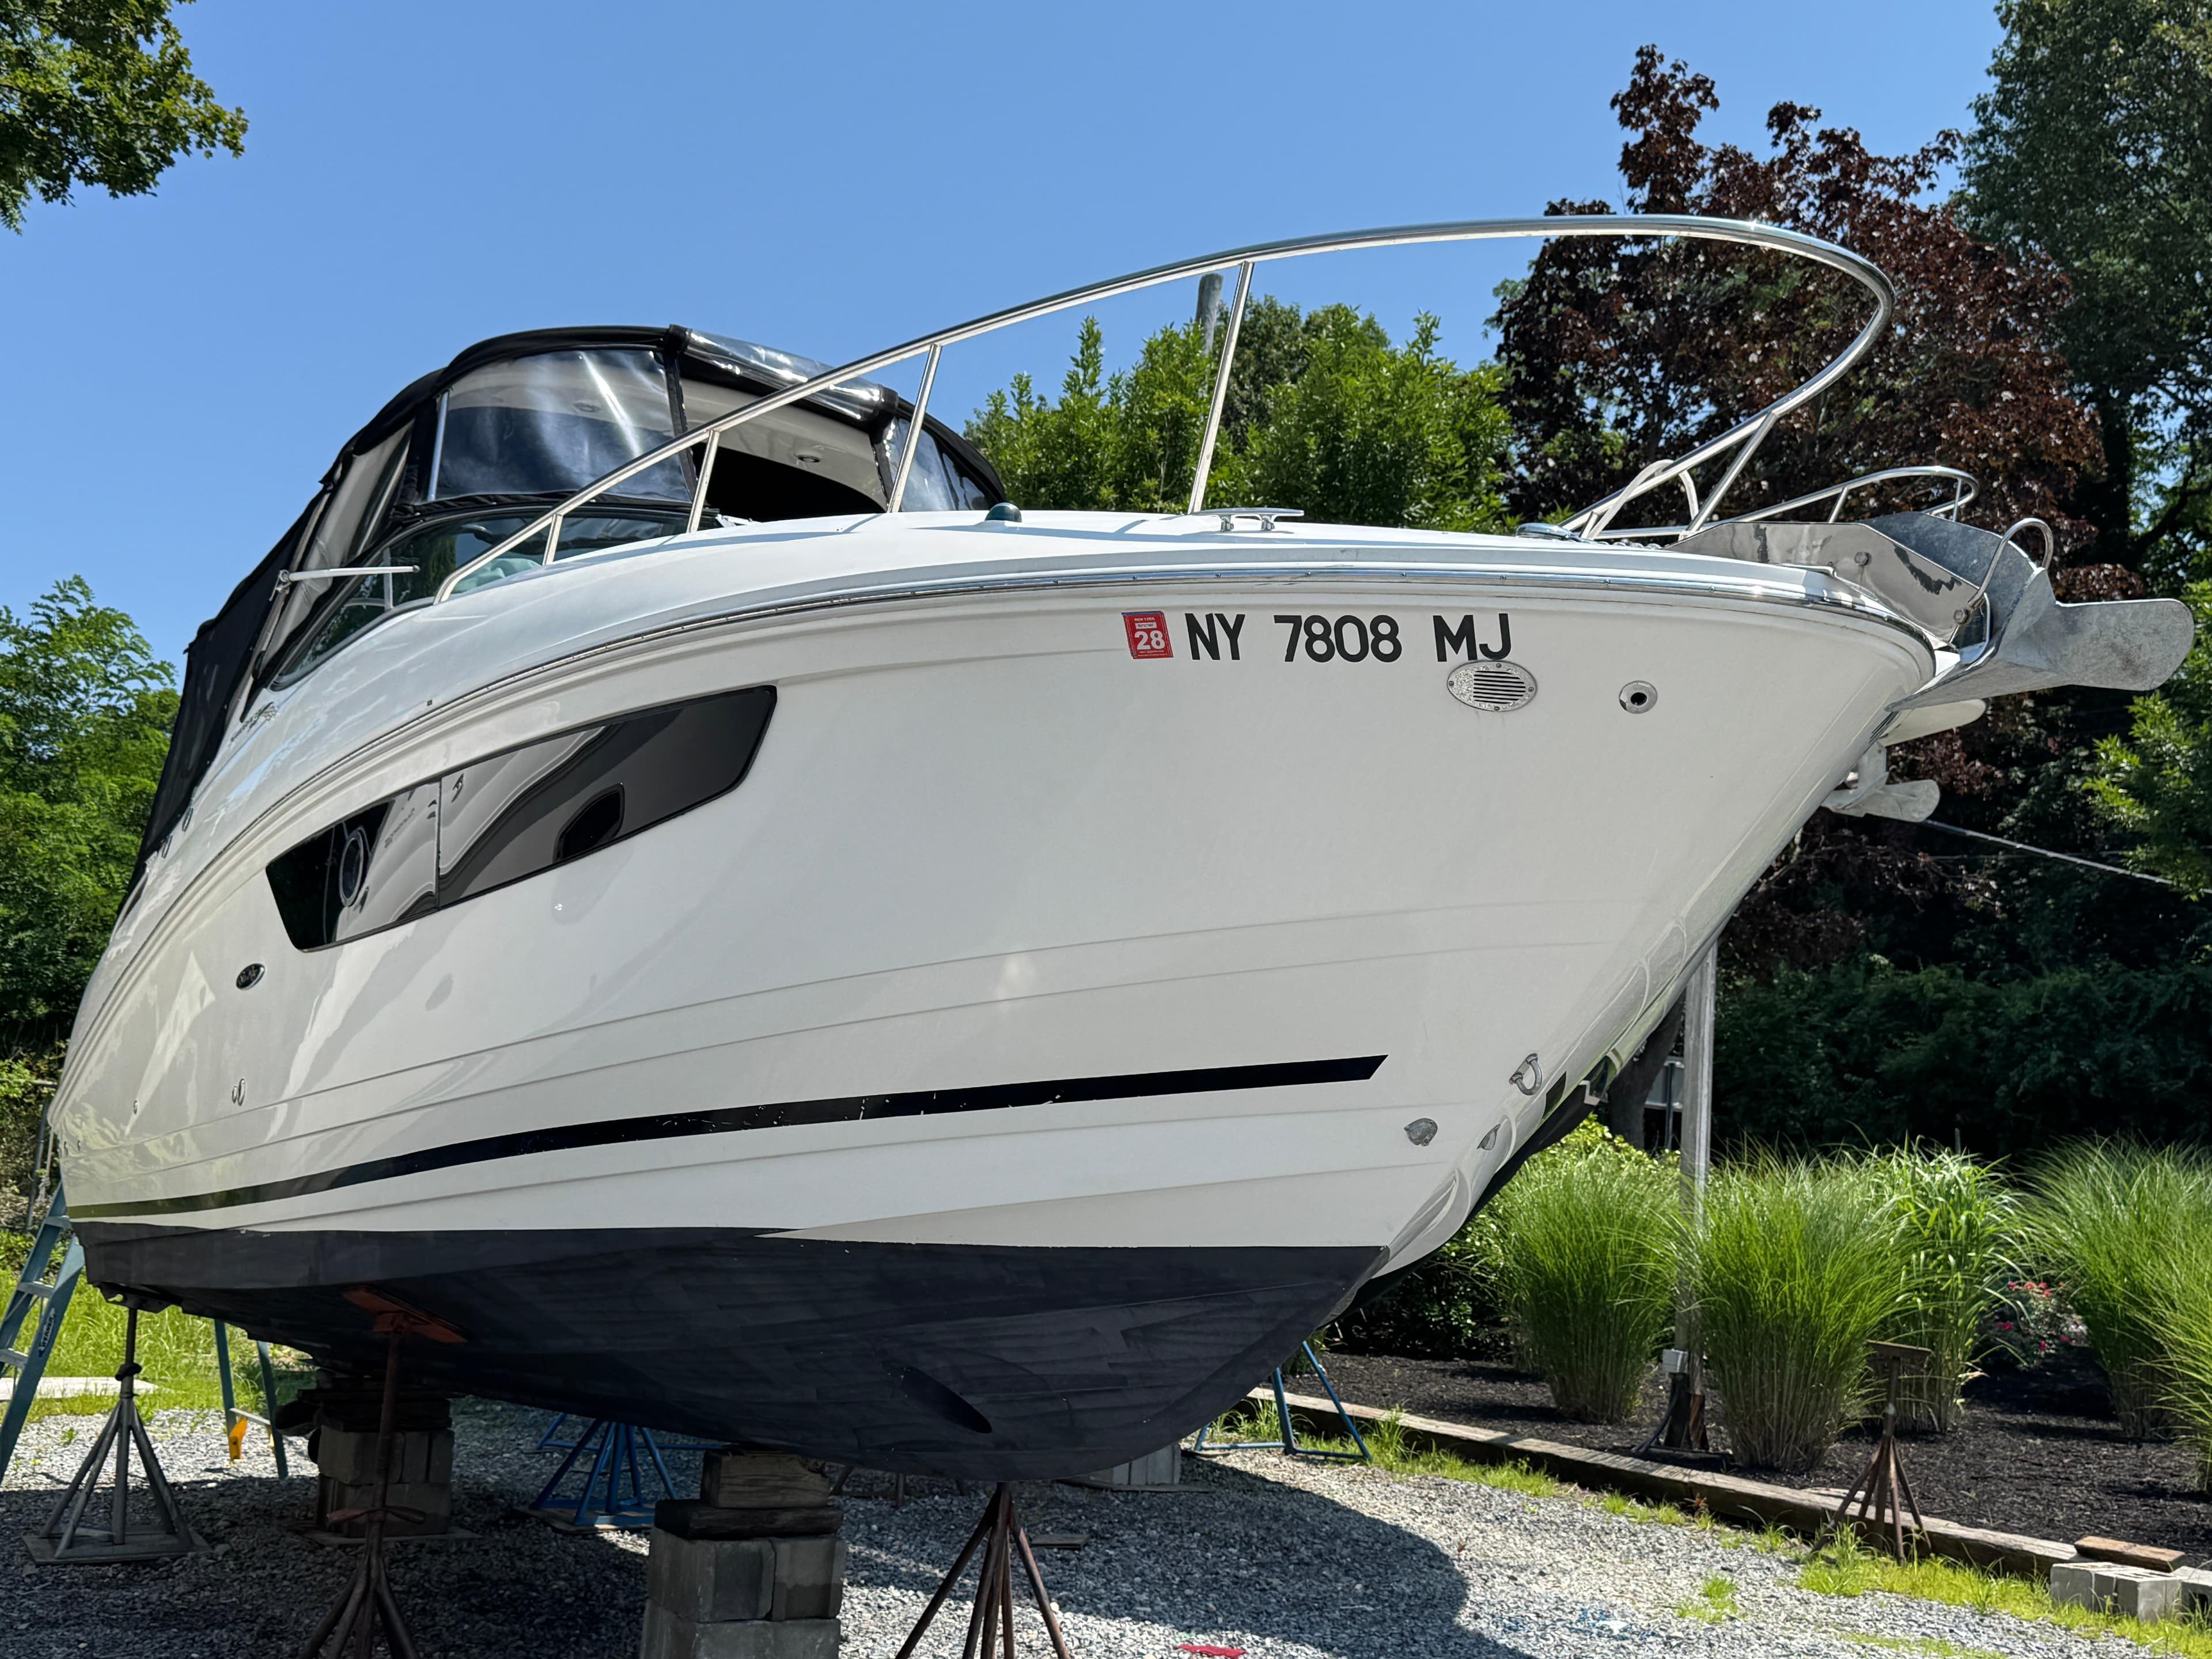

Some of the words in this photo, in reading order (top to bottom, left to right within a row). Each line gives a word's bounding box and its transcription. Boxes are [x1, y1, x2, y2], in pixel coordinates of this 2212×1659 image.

[1134, 630, 1165, 650] 28
[1185, 613, 1245, 660] NY
[1274, 615, 1402, 662] 7808
[1433, 613, 1512, 662] MJ
[41, 1316, 54, 1346] WERNER
